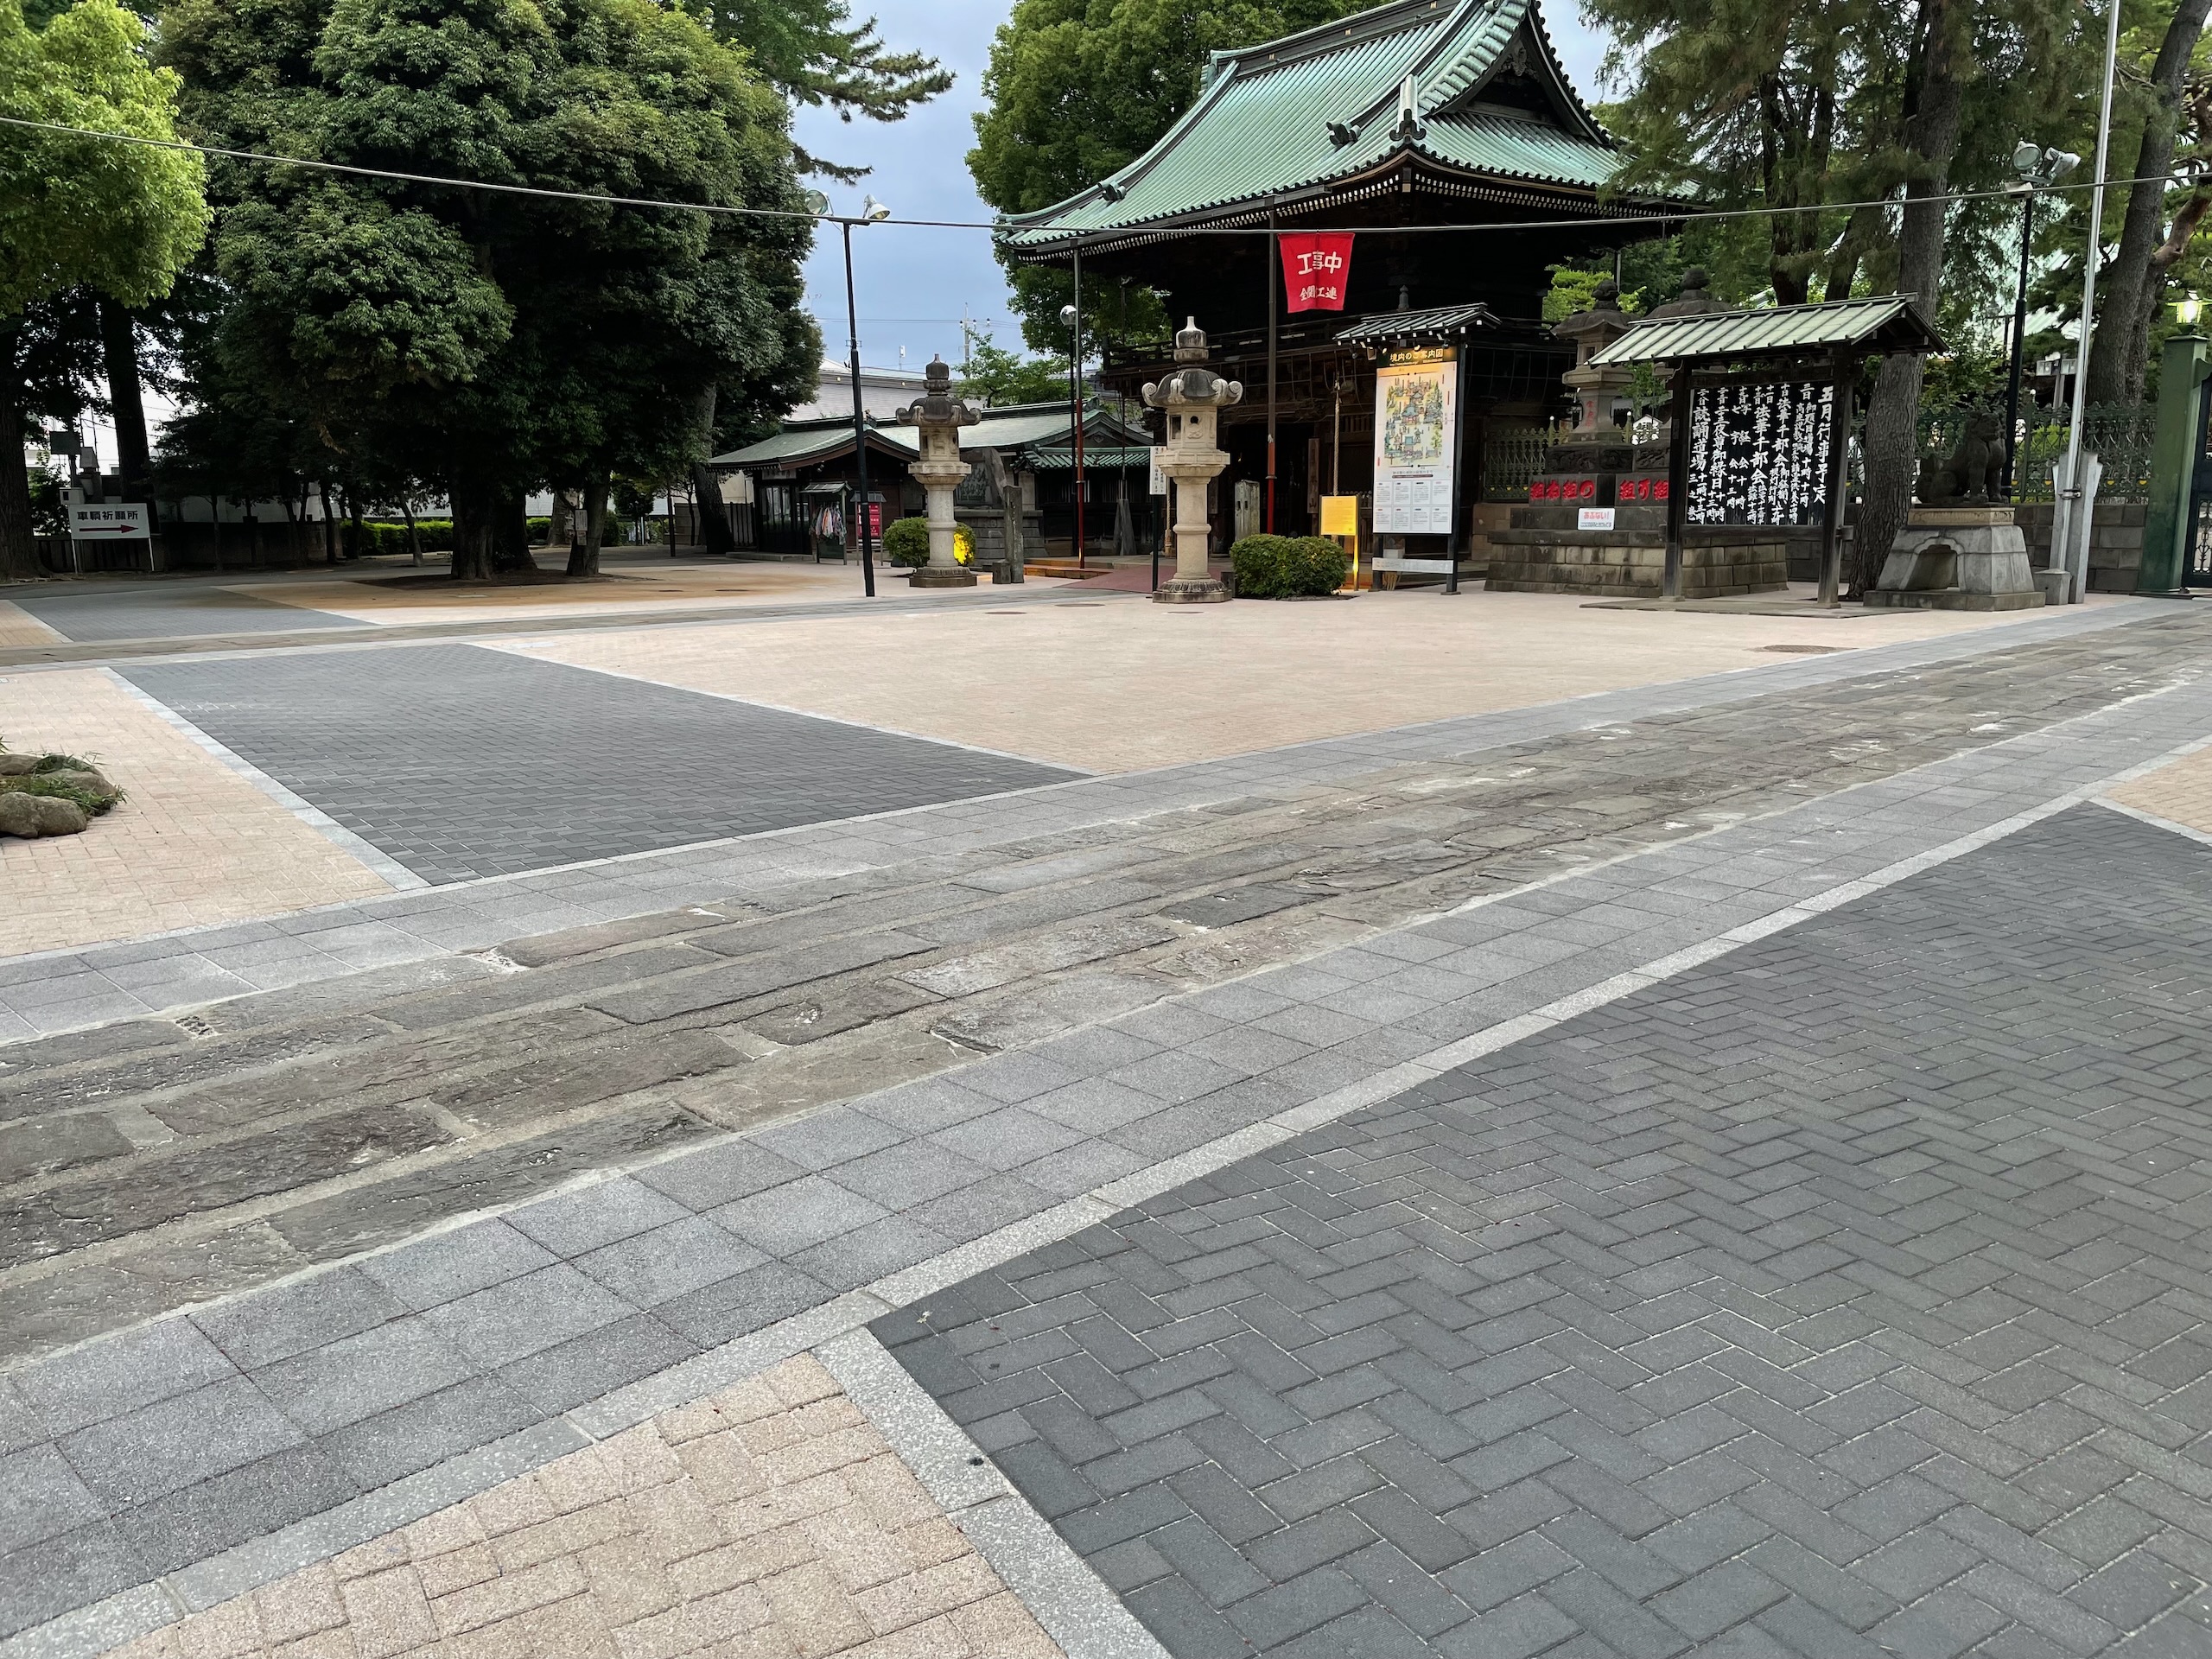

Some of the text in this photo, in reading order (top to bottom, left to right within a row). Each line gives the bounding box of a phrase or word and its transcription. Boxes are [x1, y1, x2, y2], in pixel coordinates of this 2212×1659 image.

[1297, 251, 1343, 275] 工事中
[1813, 385, 1834, 505] 五月行事予定
